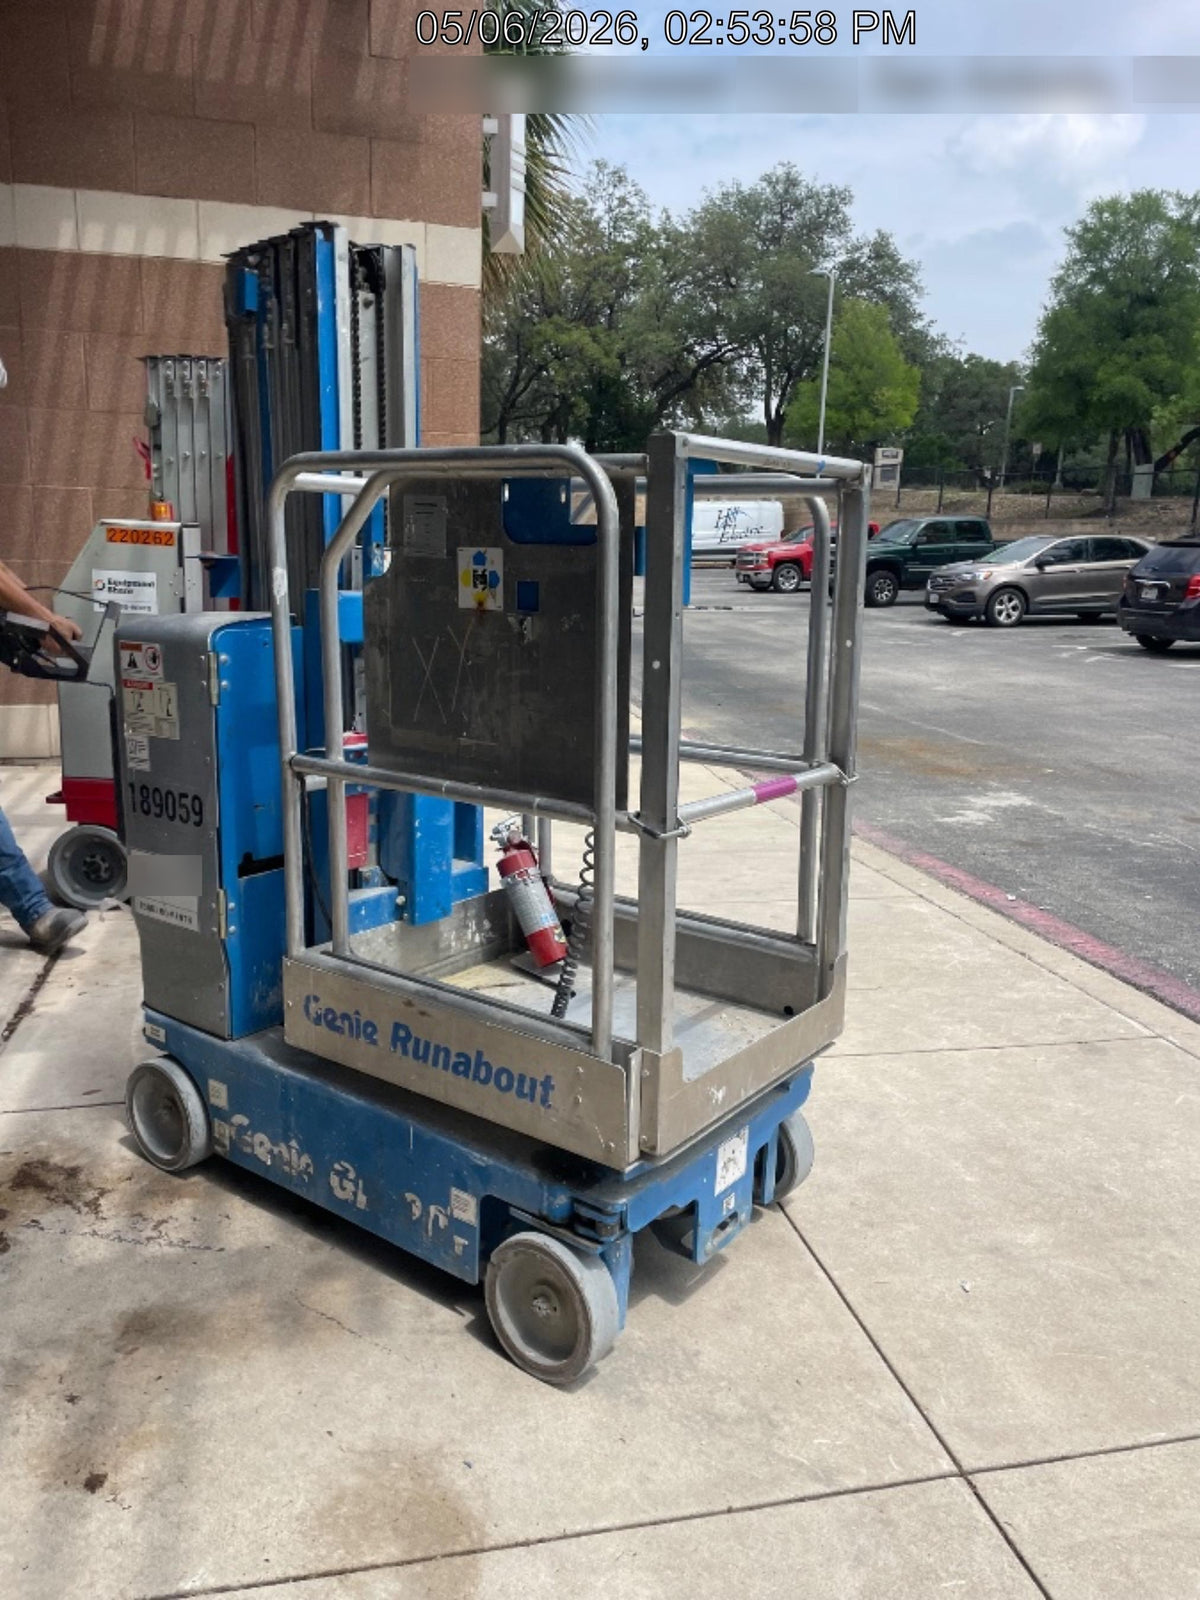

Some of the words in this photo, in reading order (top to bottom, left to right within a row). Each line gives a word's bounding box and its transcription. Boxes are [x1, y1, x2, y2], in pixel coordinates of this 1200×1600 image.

[107, 528, 174, 546] 220262
[128, 782, 204, 827] 189059
[303, 995, 378, 1046] Genie
[390, 1022, 556, 1110] Runabout
